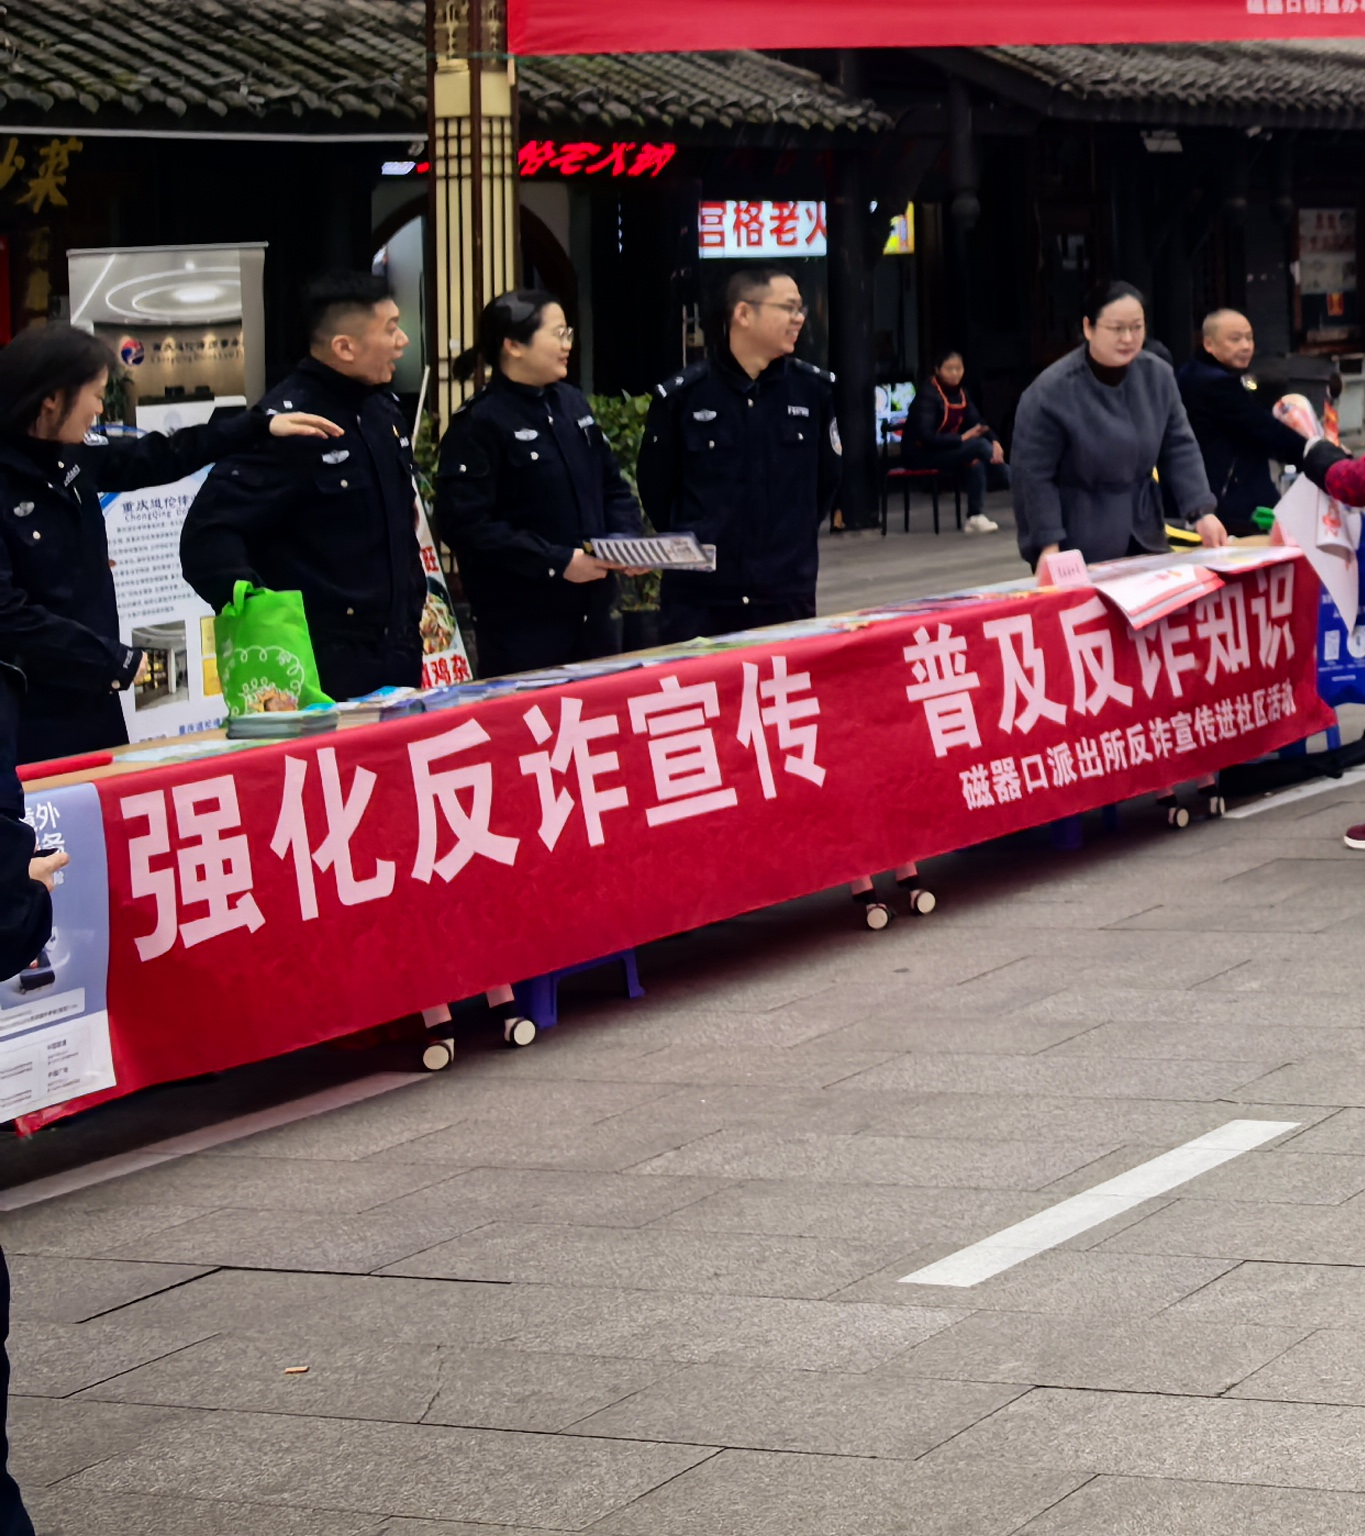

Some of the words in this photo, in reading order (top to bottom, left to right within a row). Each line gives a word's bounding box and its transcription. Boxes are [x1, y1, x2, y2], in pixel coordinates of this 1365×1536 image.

[119, 655, 827, 963] 强化反诈宣传
[902, 562, 1296, 758] 普及反诈知识
[959, 681, 1298, 811] 磁器口派出所反诈宣传进社区活动
